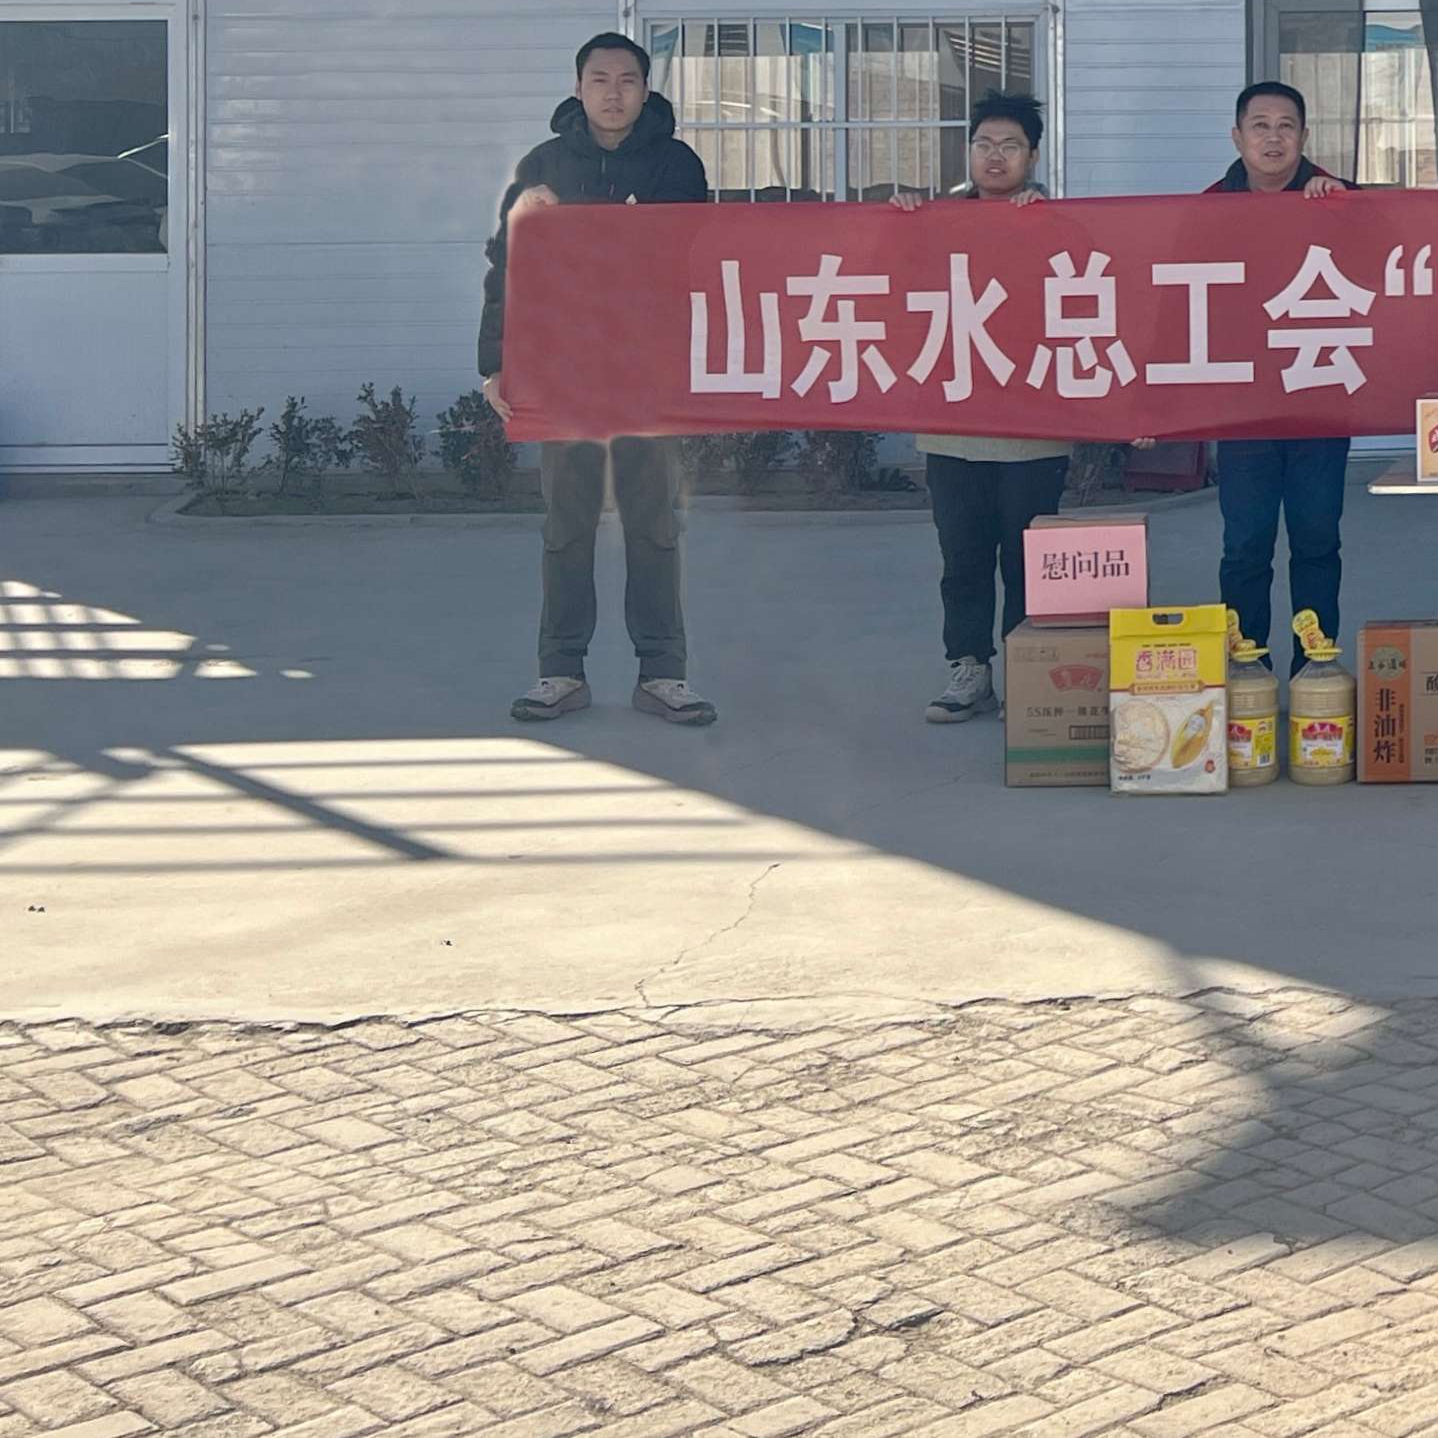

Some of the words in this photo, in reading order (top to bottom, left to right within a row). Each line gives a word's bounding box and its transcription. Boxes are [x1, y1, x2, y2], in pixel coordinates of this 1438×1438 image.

[1041, 549, 1130, 580] 慰问品
[1136, 648, 1197, 672] 香满园
[1374, 688, 1397, 764] 非油炸
